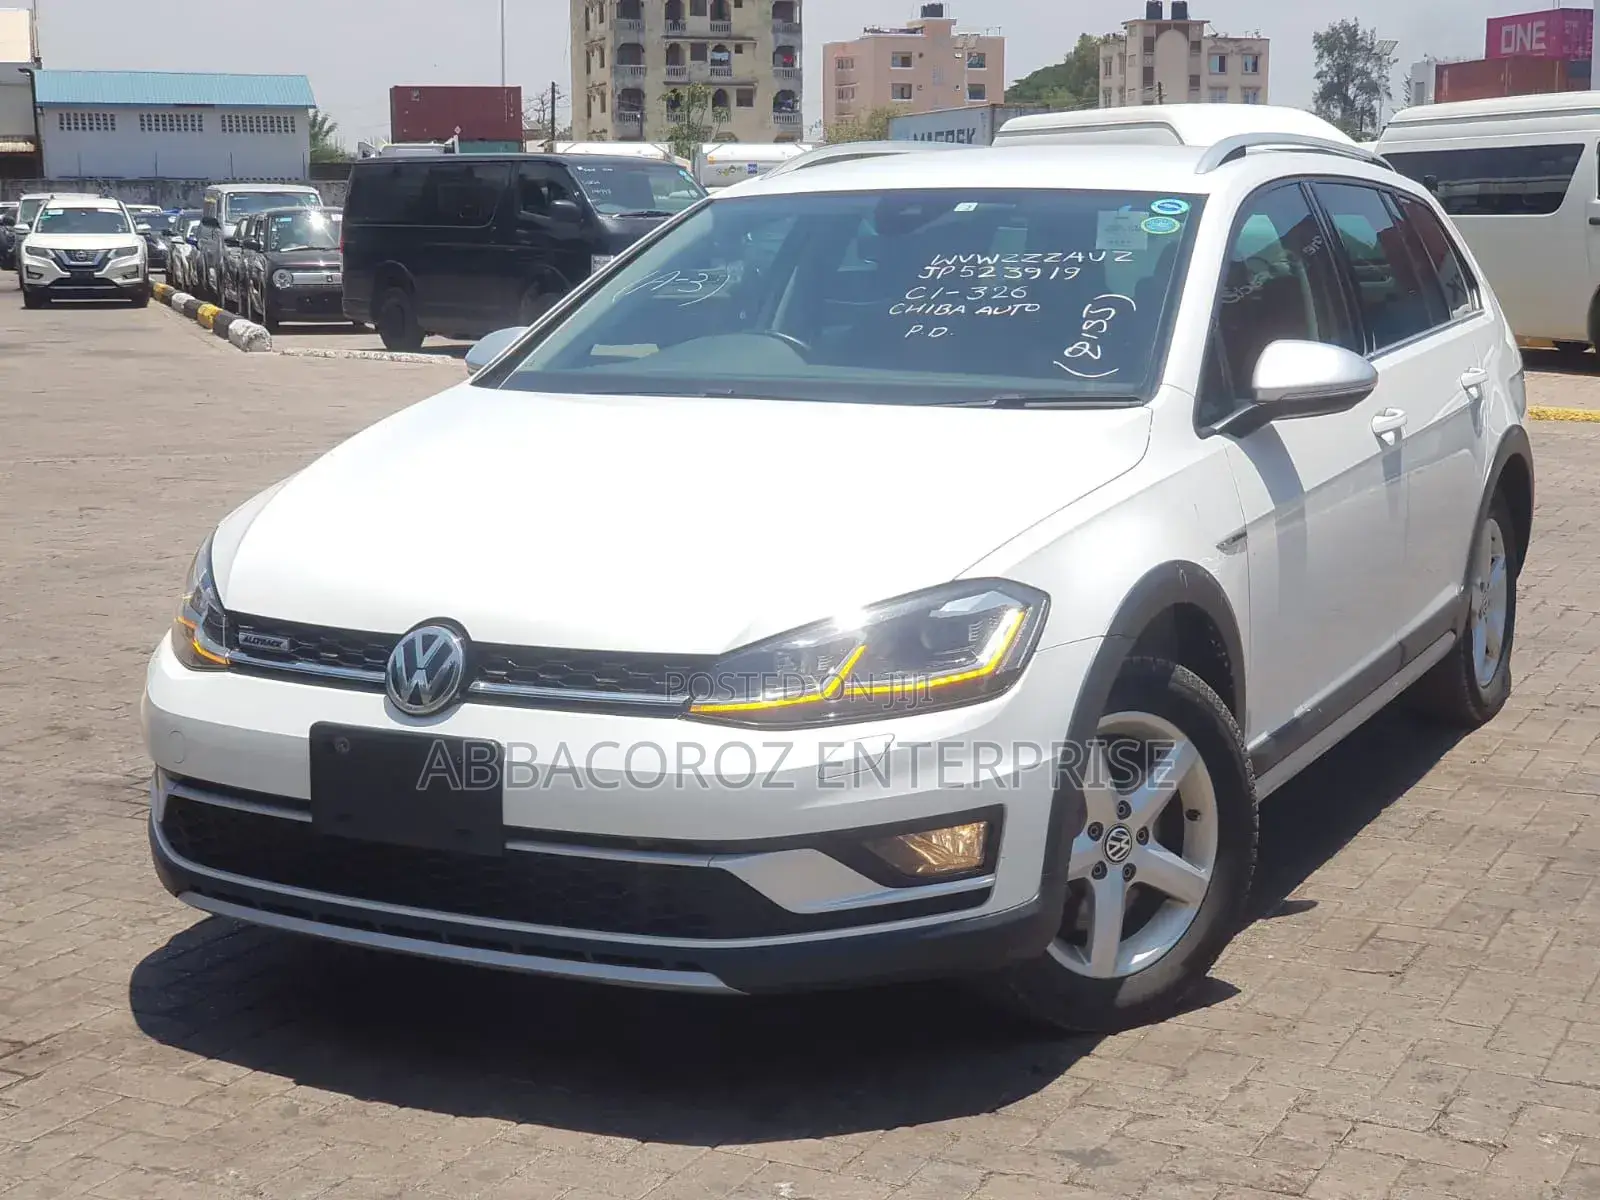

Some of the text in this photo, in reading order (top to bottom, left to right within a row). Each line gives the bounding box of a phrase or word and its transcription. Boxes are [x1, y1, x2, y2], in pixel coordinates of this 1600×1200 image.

[1501, 20, 1547, 54] ONE
[917, 265, 1081, 281] JP523919
[889, 302, 1041, 317] CHIBA AUTO
